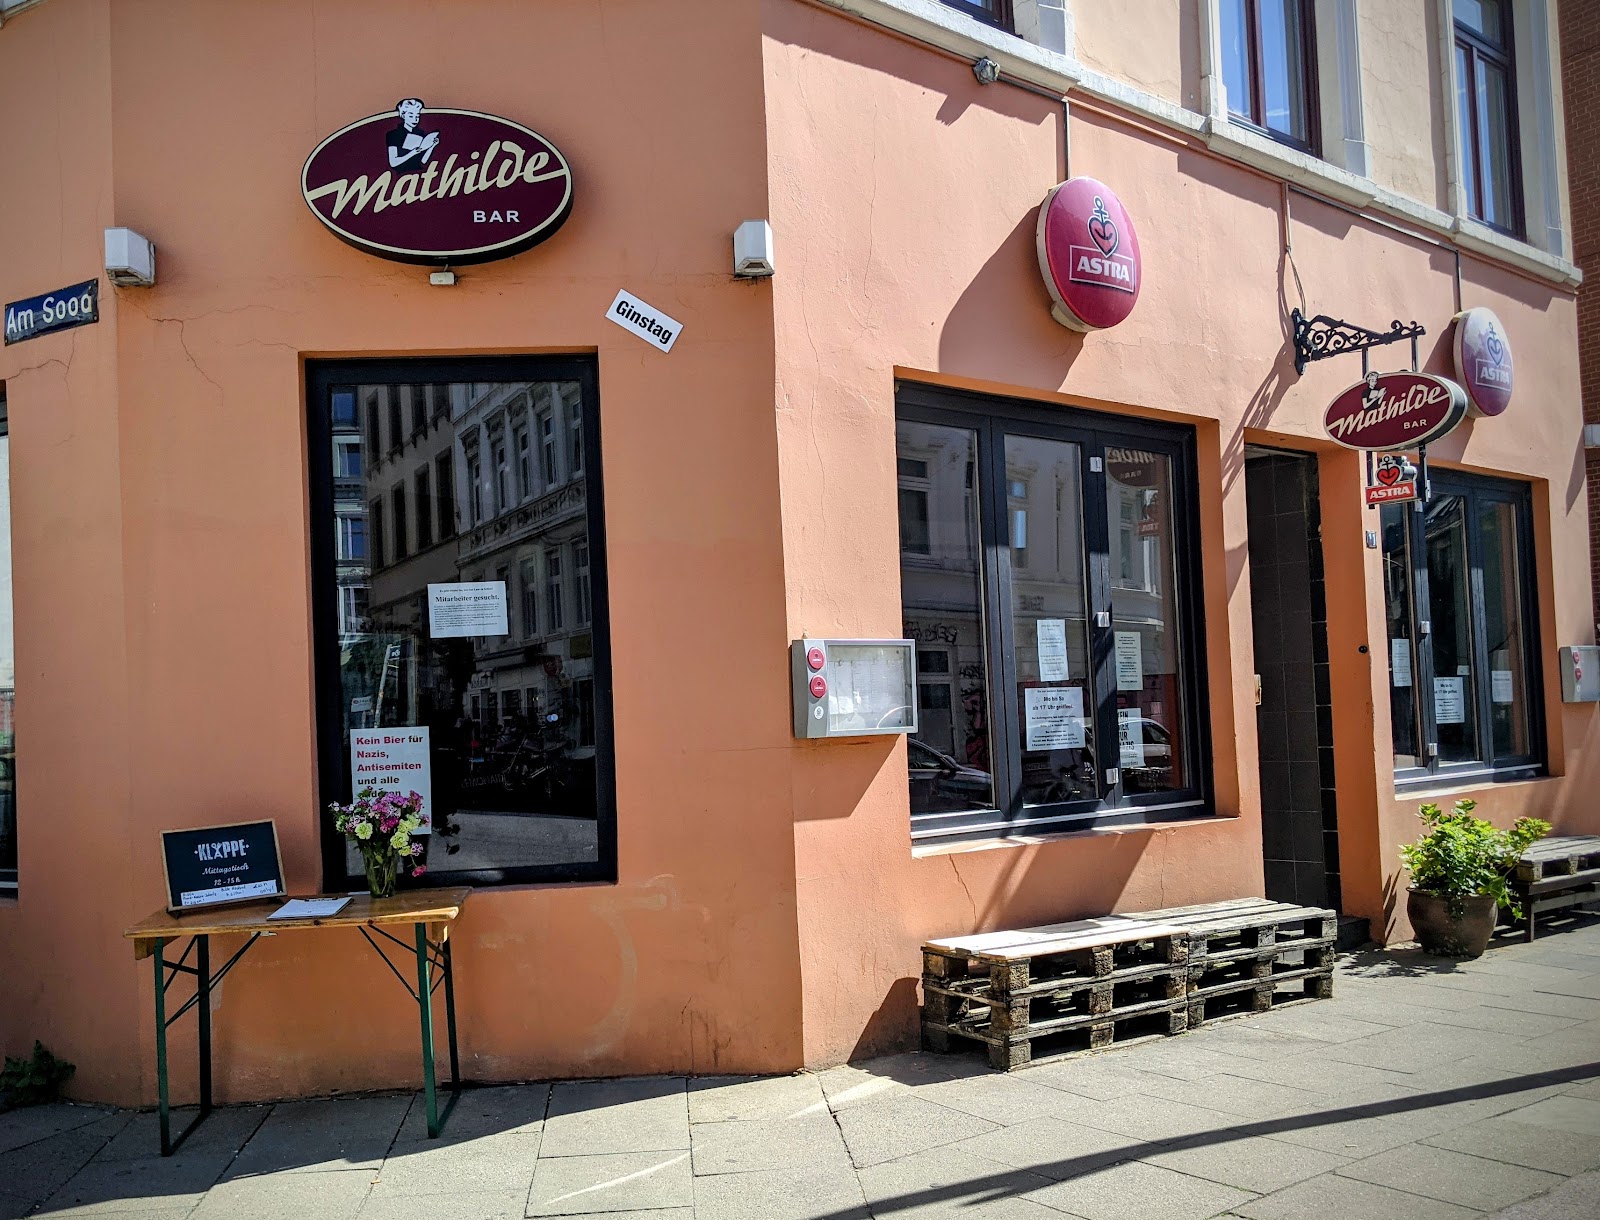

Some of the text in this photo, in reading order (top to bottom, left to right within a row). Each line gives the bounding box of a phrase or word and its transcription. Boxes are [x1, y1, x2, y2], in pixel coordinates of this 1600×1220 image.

[307, 140, 567, 219] Mathilde
[473, 210, 520, 223] BAR
[1077, 256, 1130, 282] ASTRA
[6, 307, 34, 334] Am
[615, 300, 673, 345] Ginstag
[1480, 366, 1512, 385] ASTRA
[1328, 385, 1450, 439] Mathilde
[1403, 419, 1427, 429] BAR
[1369, 486, 1411, 499] ASTRA
[474, 593, 500, 602] gesucht.
[356, 735, 424, 745] Kein Bier für
[356, 751, 390, 760] Nazis,
[357, 762, 422, 773] Antisemiten
[357, 777, 400, 785] und alle
[202, 862, 250, 876] Mittagstisch
